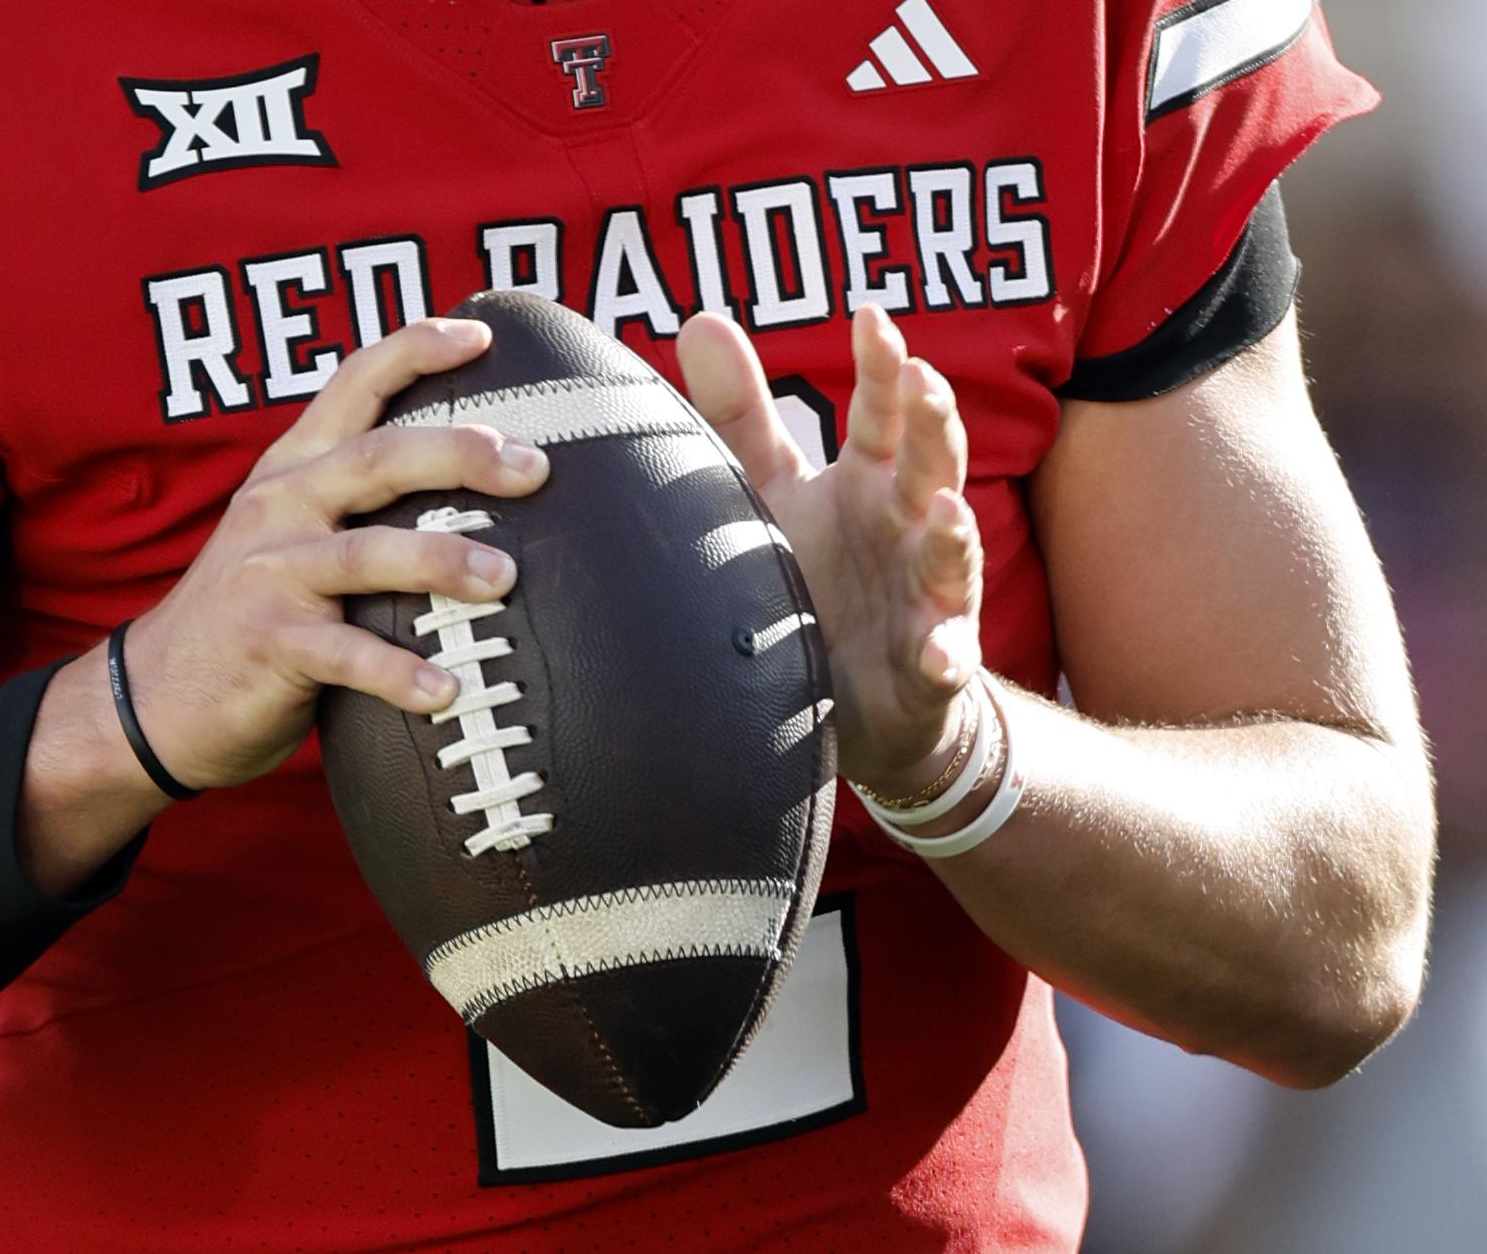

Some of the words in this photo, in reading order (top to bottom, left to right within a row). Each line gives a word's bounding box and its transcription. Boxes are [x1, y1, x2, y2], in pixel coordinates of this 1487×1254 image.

[130, 63, 327, 182] XII
[144, 235, 431, 420] RED
[479, 158, 1054, 339] RAIDERS
